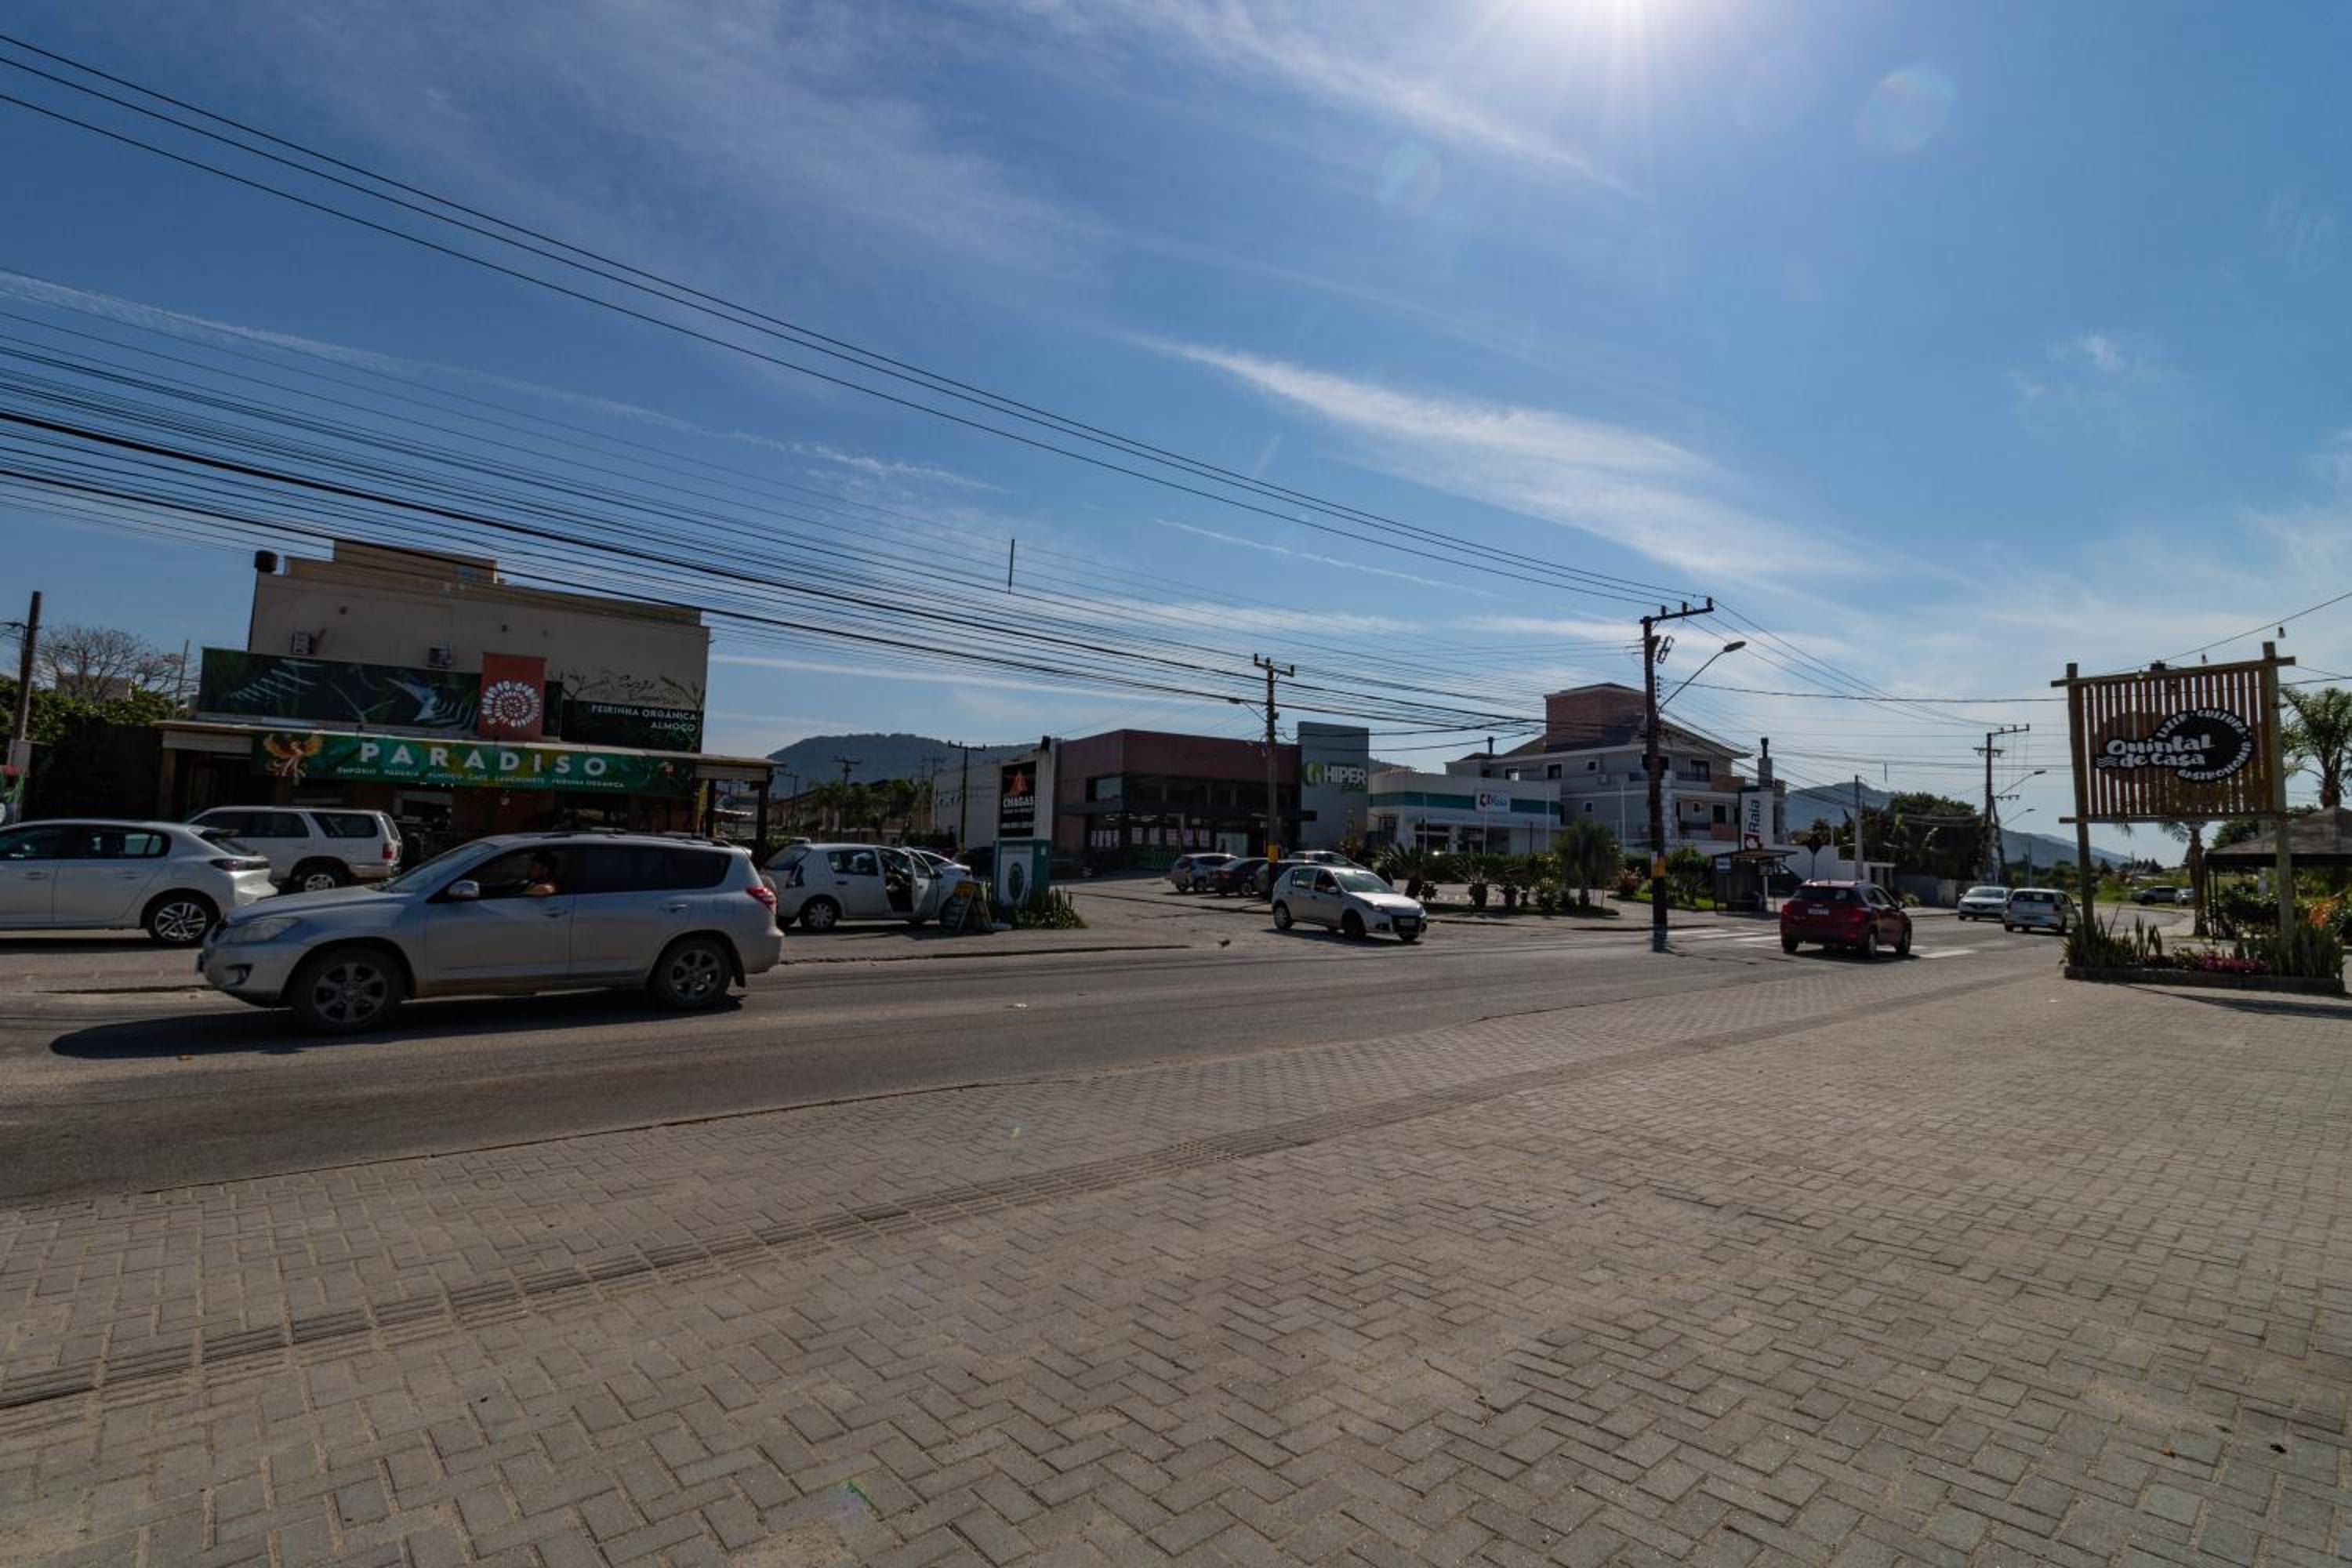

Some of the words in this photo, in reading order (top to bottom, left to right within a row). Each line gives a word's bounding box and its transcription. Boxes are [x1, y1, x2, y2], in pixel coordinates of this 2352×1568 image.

[591, 704, 639, 716] FEIRINHA
[2106, 733, 2217, 756] Quintal
[359, 742, 608, 776] PARADISO
[2119, 753, 2150, 768] de
[1324, 765, 1367, 786] HIPER
[1748, 800, 1760, 833] Raia
